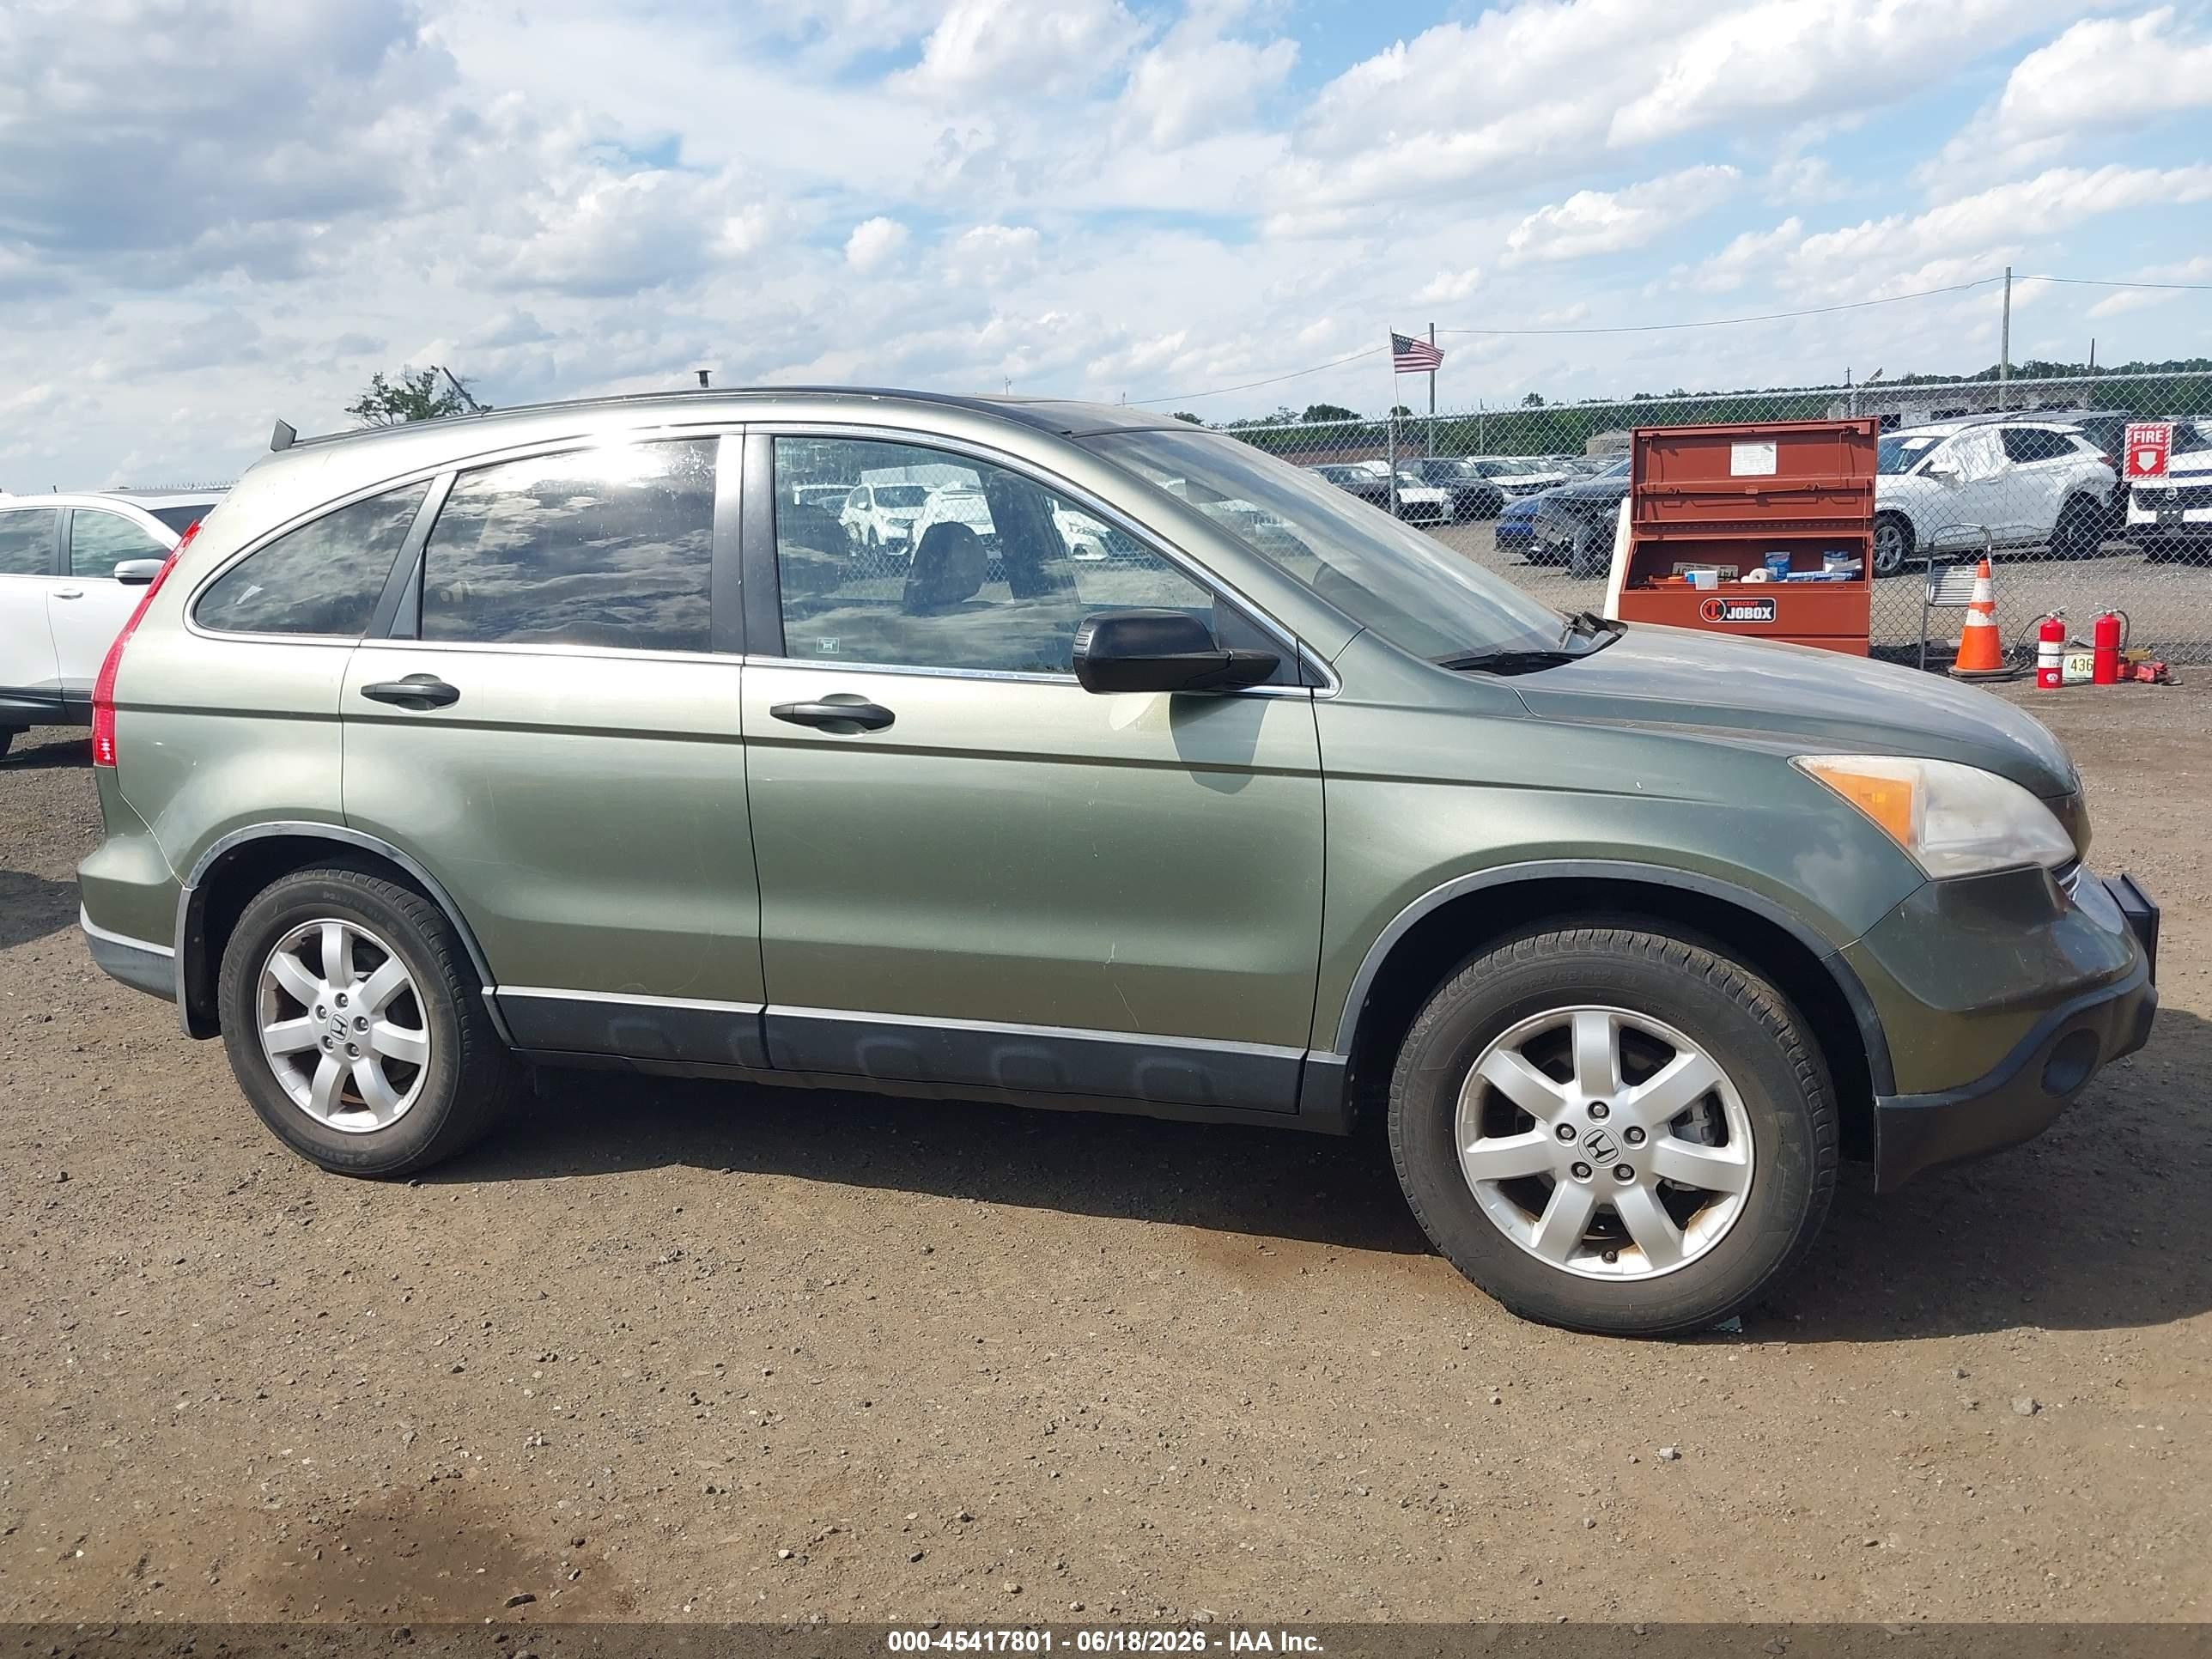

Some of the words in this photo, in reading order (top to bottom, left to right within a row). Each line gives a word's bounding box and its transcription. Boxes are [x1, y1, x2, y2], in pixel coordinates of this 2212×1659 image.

[2133, 430, 2165, 443] FIRE
[1726, 607, 1772, 619] JOBOX
[2070, 658, 2094, 672] 436
